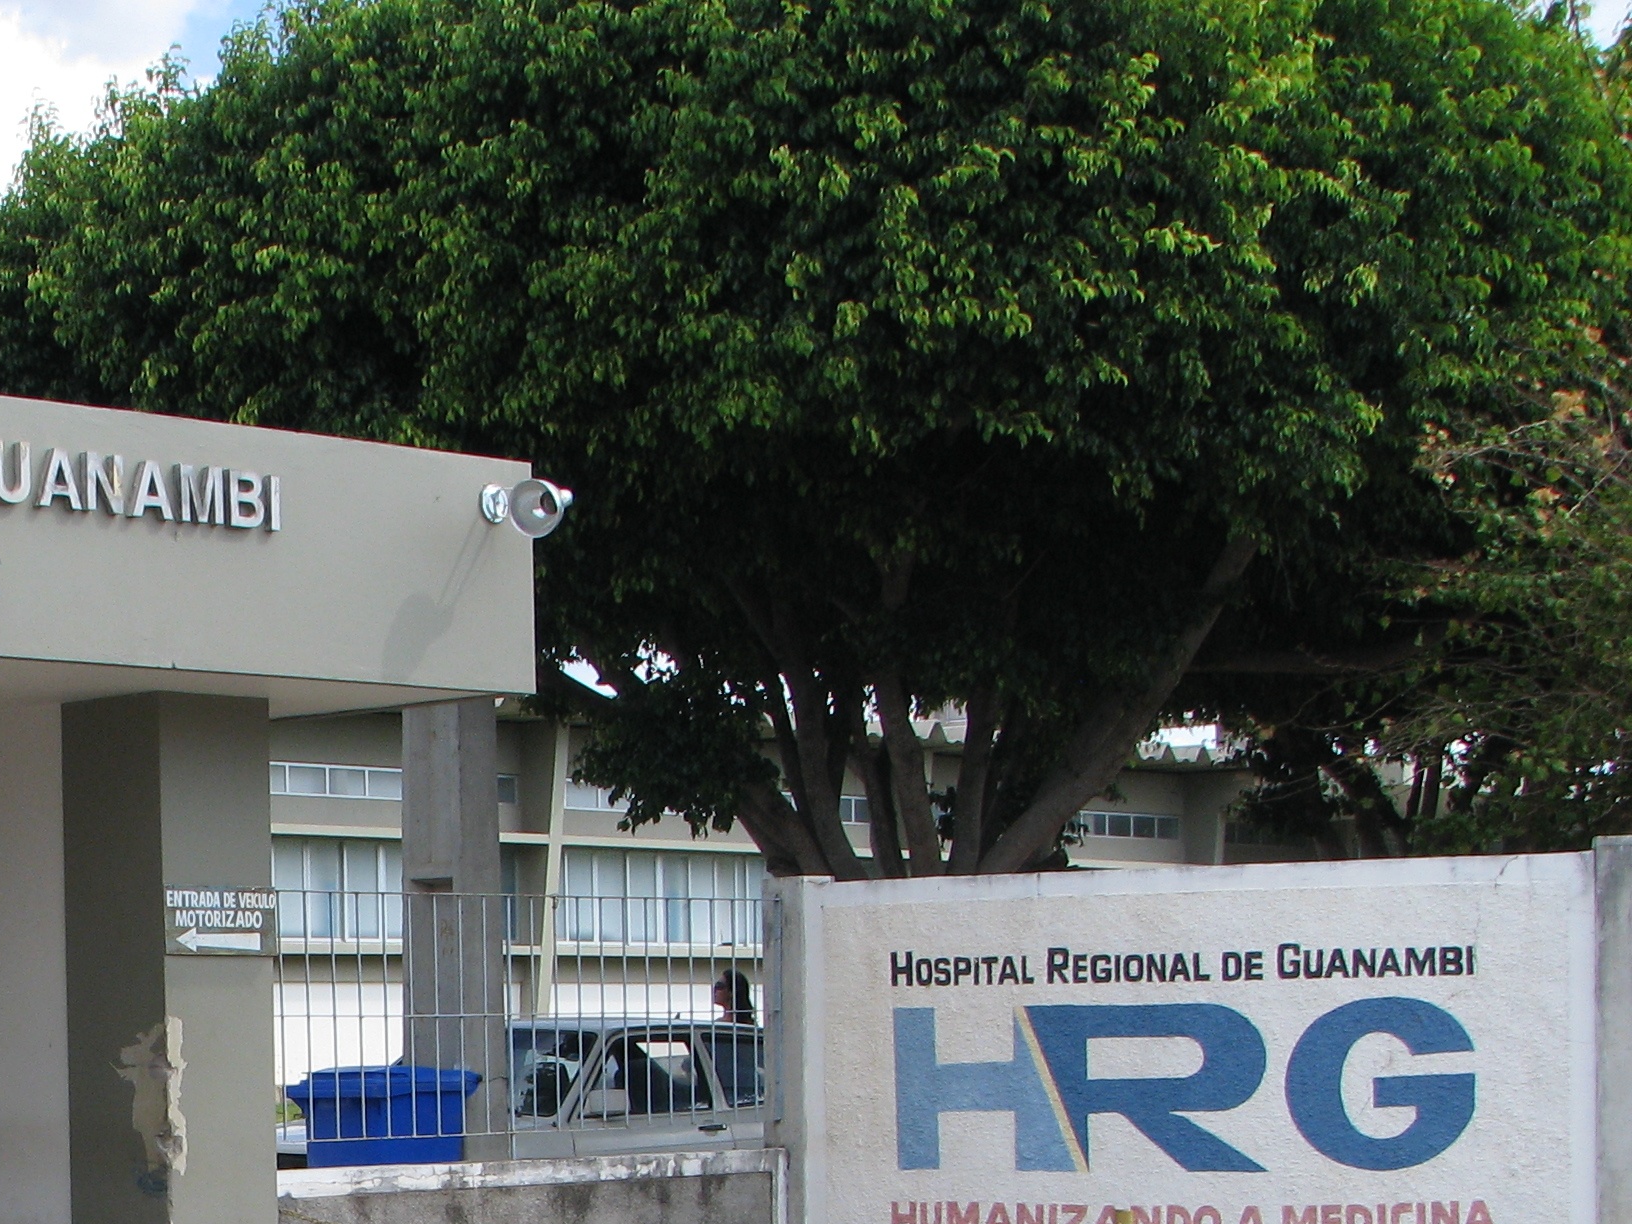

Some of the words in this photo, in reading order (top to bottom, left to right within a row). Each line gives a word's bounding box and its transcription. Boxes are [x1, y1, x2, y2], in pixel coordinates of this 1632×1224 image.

[166, 889, 221, 909] ENTRADA
[223, 891, 237, 909] DE
[175, 909, 263, 929] MOTORIZADO
[889, 950, 1035, 987] HOSPITAL
[1045, 946, 1211, 985] REGIONAL
[1221, 950, 1264, 982] DE
[1276, 942, 1475, 980] GUANAMBI
[892, 996, 1477, 1172] HRG
